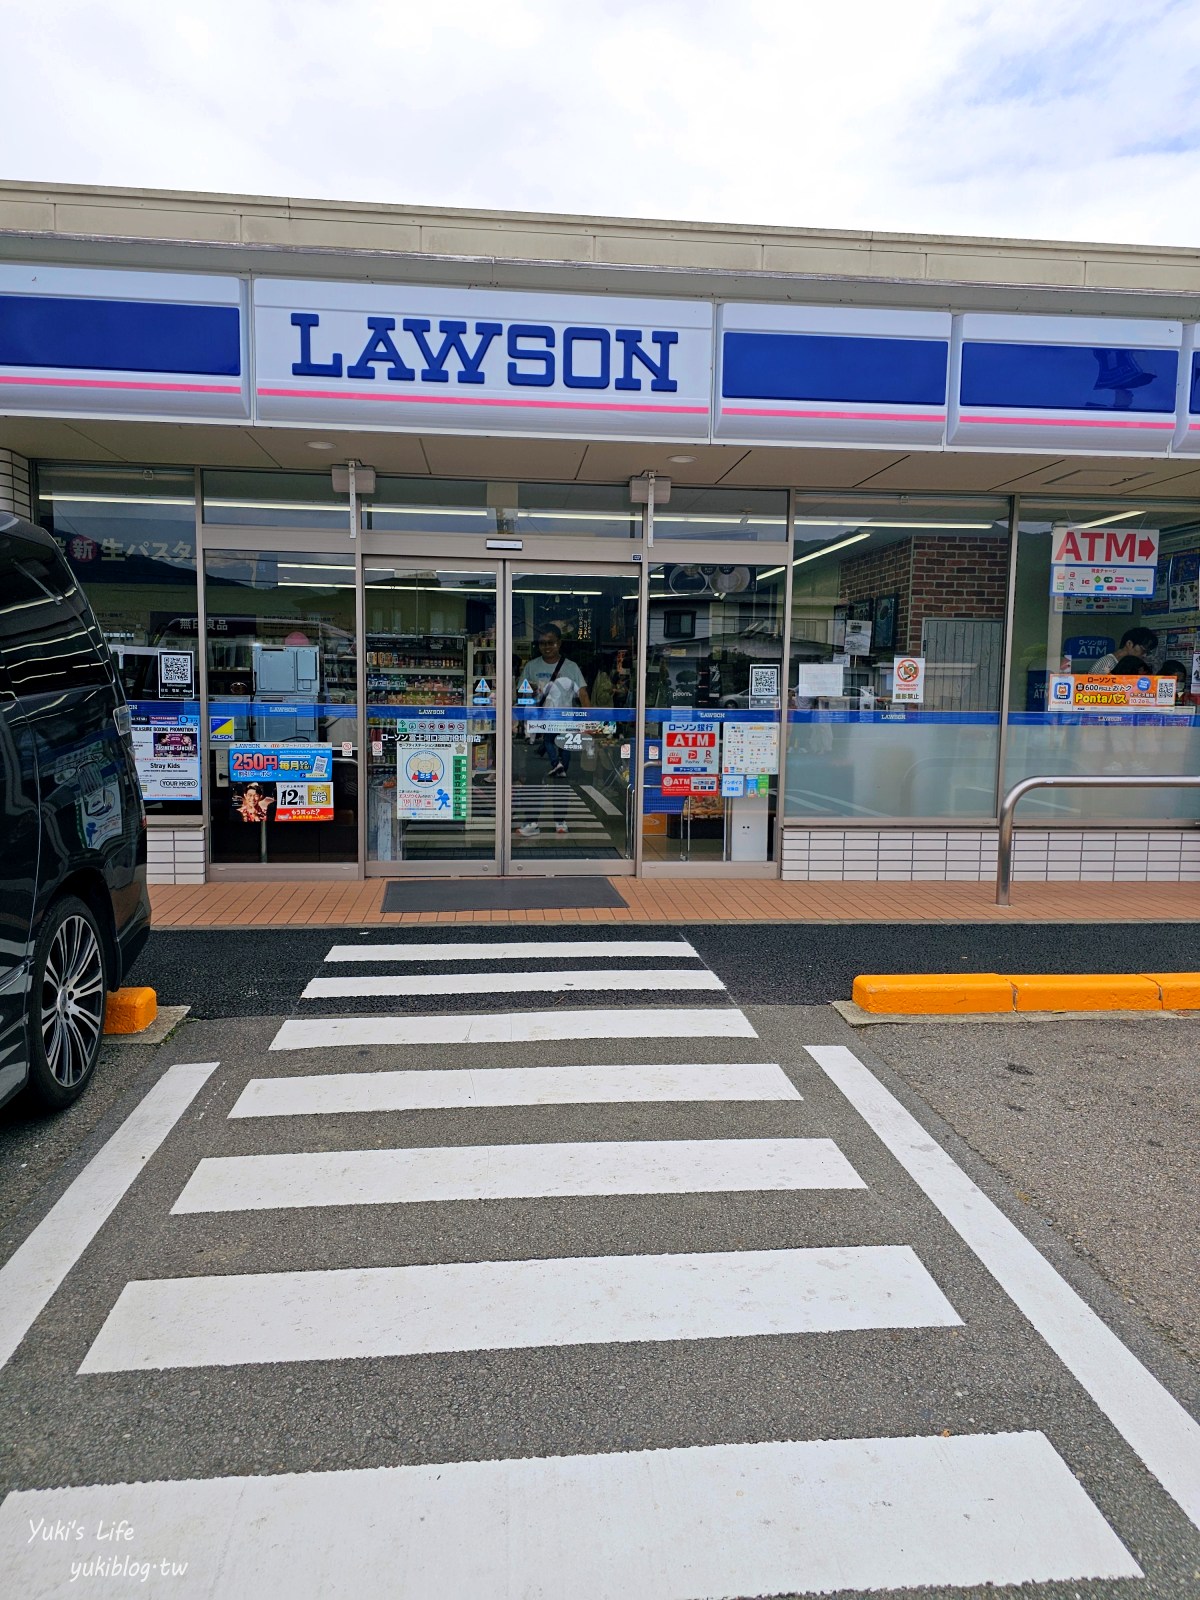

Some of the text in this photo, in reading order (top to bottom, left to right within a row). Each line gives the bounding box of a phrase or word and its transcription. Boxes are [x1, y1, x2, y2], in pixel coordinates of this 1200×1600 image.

[290, 312, 679, 392] LAWSON
[72, 539, 93, 559] 新
[101, 538, 192, 562] 生パスタ
[1055, 532, 1137, 562] ATM
[1078, 646, 1108, 655] ATM
[1075, 692, 1127, 704] Pontaパス
[669, 723, 714, 732] ローソン銀行
[565, 733, 582, 745] 24
[673, 734, 709, 746] ATM
[233, 753, 278, 771] 250円
